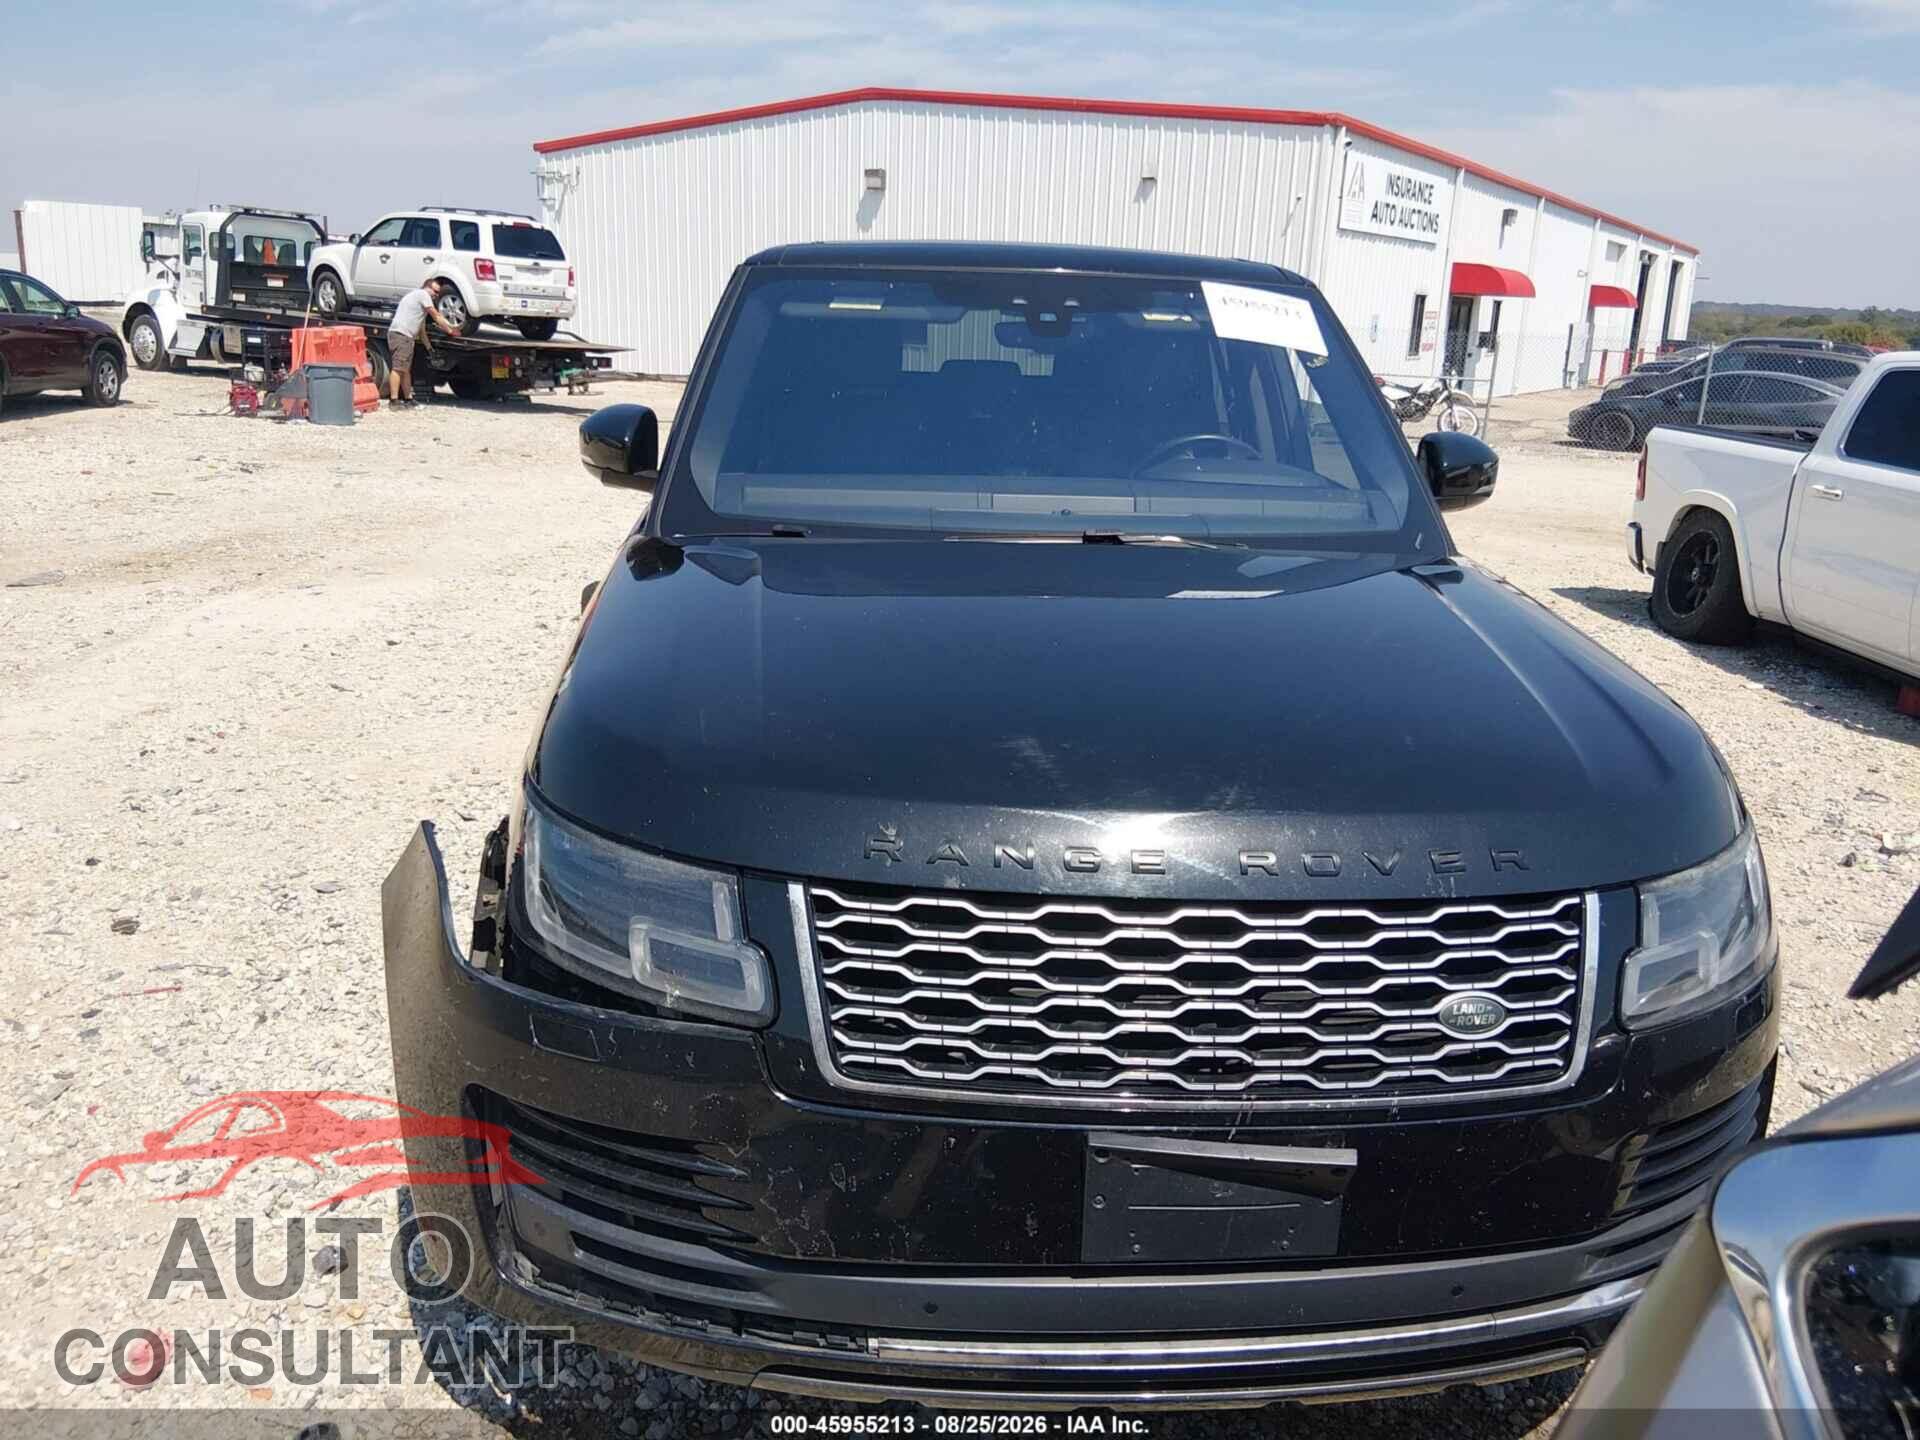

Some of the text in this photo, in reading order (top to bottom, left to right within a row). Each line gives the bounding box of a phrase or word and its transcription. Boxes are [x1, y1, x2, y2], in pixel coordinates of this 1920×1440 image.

[1385, 172, 1434, 205] INSURANCE
[1371, 200, 1397, 226] AUTO
[1398, 206, 1440, 233] AUCTIONS
[863, 832, 1530, 877] RANGE ROVER
[1453, 1003, 1485, 1015] LAND
[1457, 1014, 1496, 1026] ROVER
